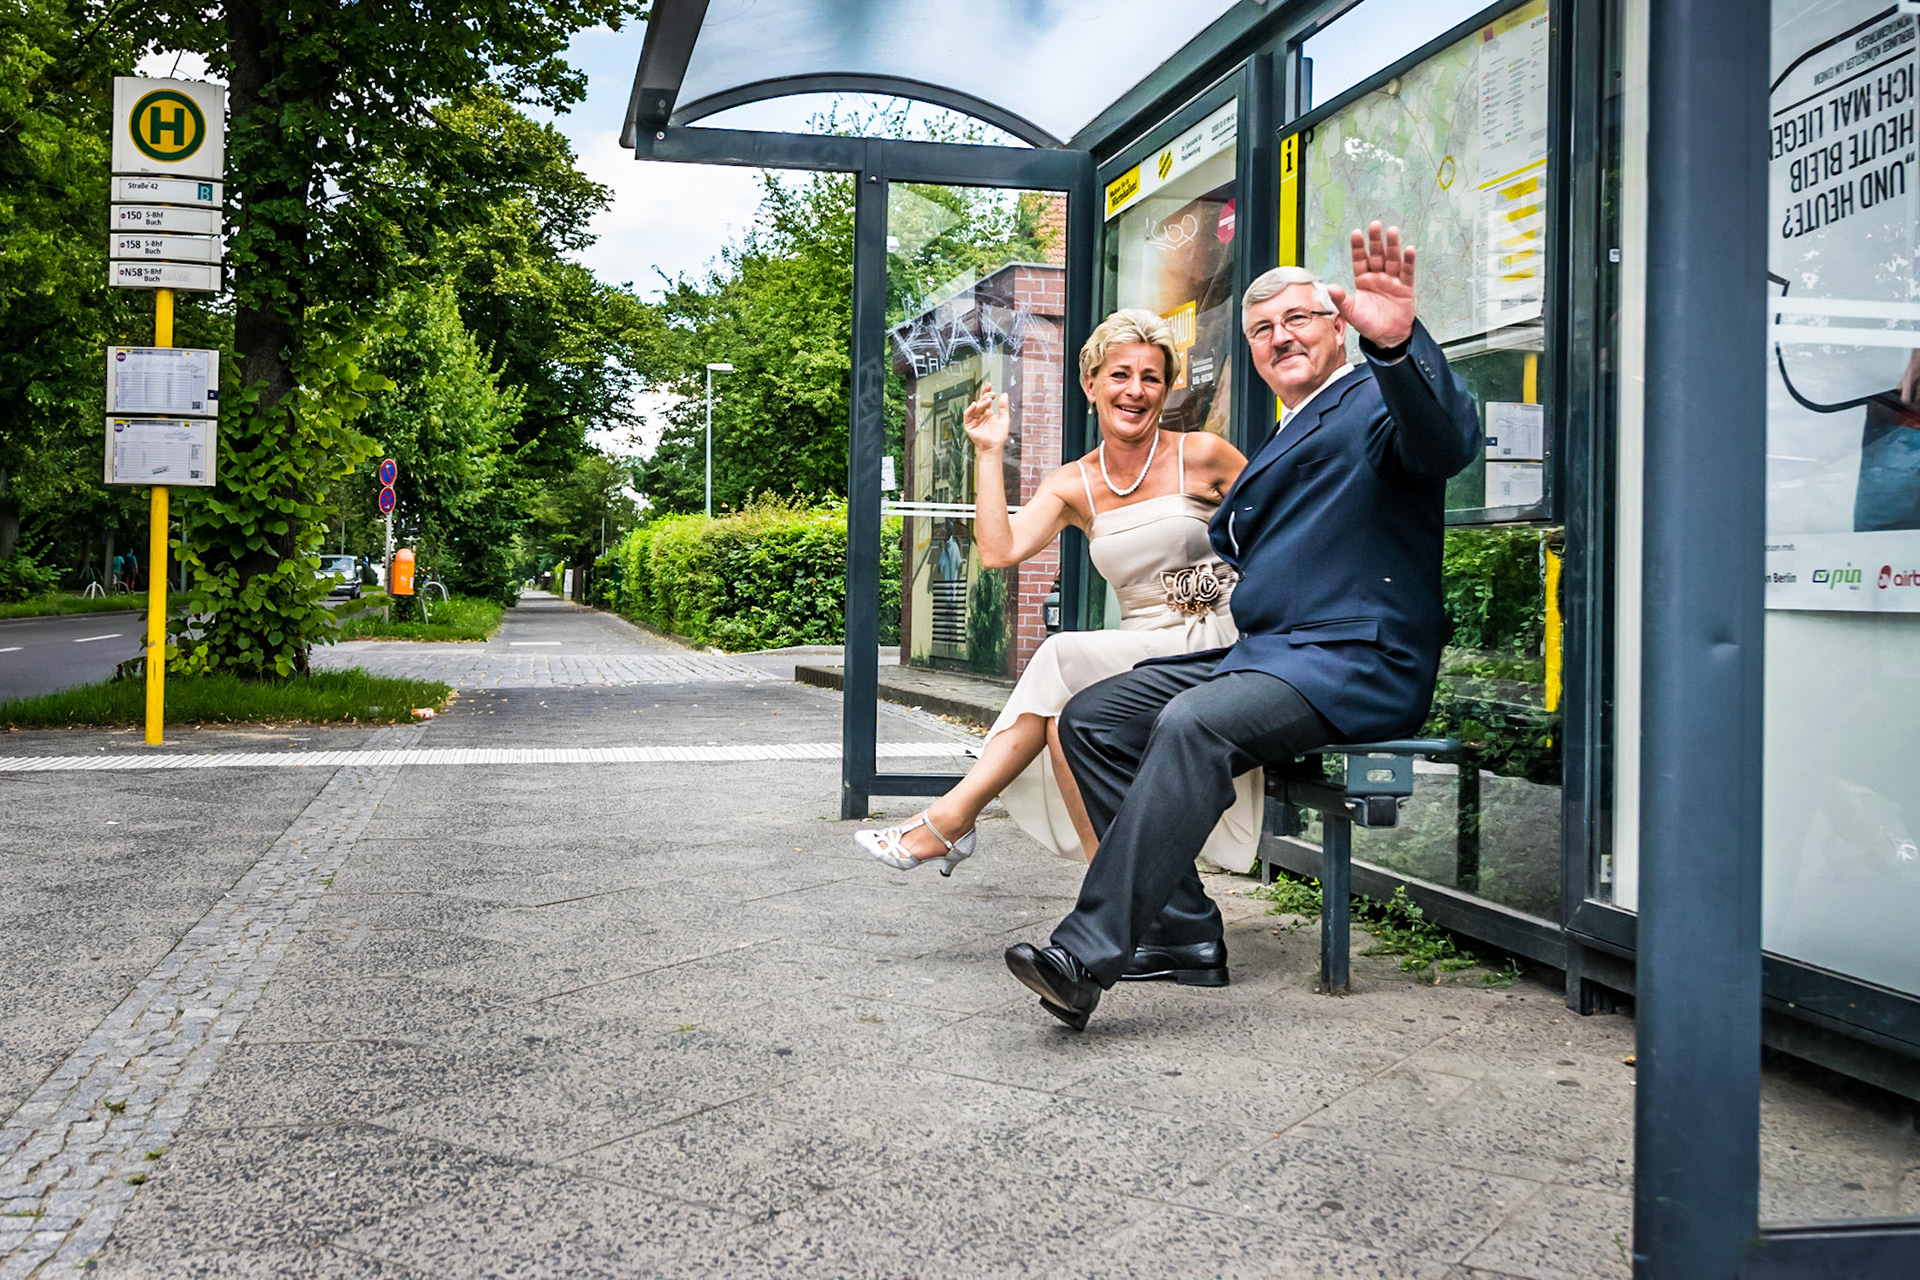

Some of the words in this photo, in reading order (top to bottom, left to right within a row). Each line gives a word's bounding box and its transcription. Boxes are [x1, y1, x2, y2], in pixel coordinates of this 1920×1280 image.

[1877, 62, 1914, 112] ICH
[1829, 82, 1871, 132] MAL
[150, 106, 184, 146] H
[1848, 109, 1914, 170] HEUTE
[1790, 141, 1843, 193] BLEIB
[128, 182, 149, 190] Straße
[126, 211, 142, 220] 150
[1782, 180, 1854, 239] HEUTE?
[126, 240, 141, 249] 158
[124, 268, 143, 277] N58
[143, 275, 160, 283] Buch
[1773, 572, 1796, 583] Berlin
[1830, 562, 1862, 590] pin
